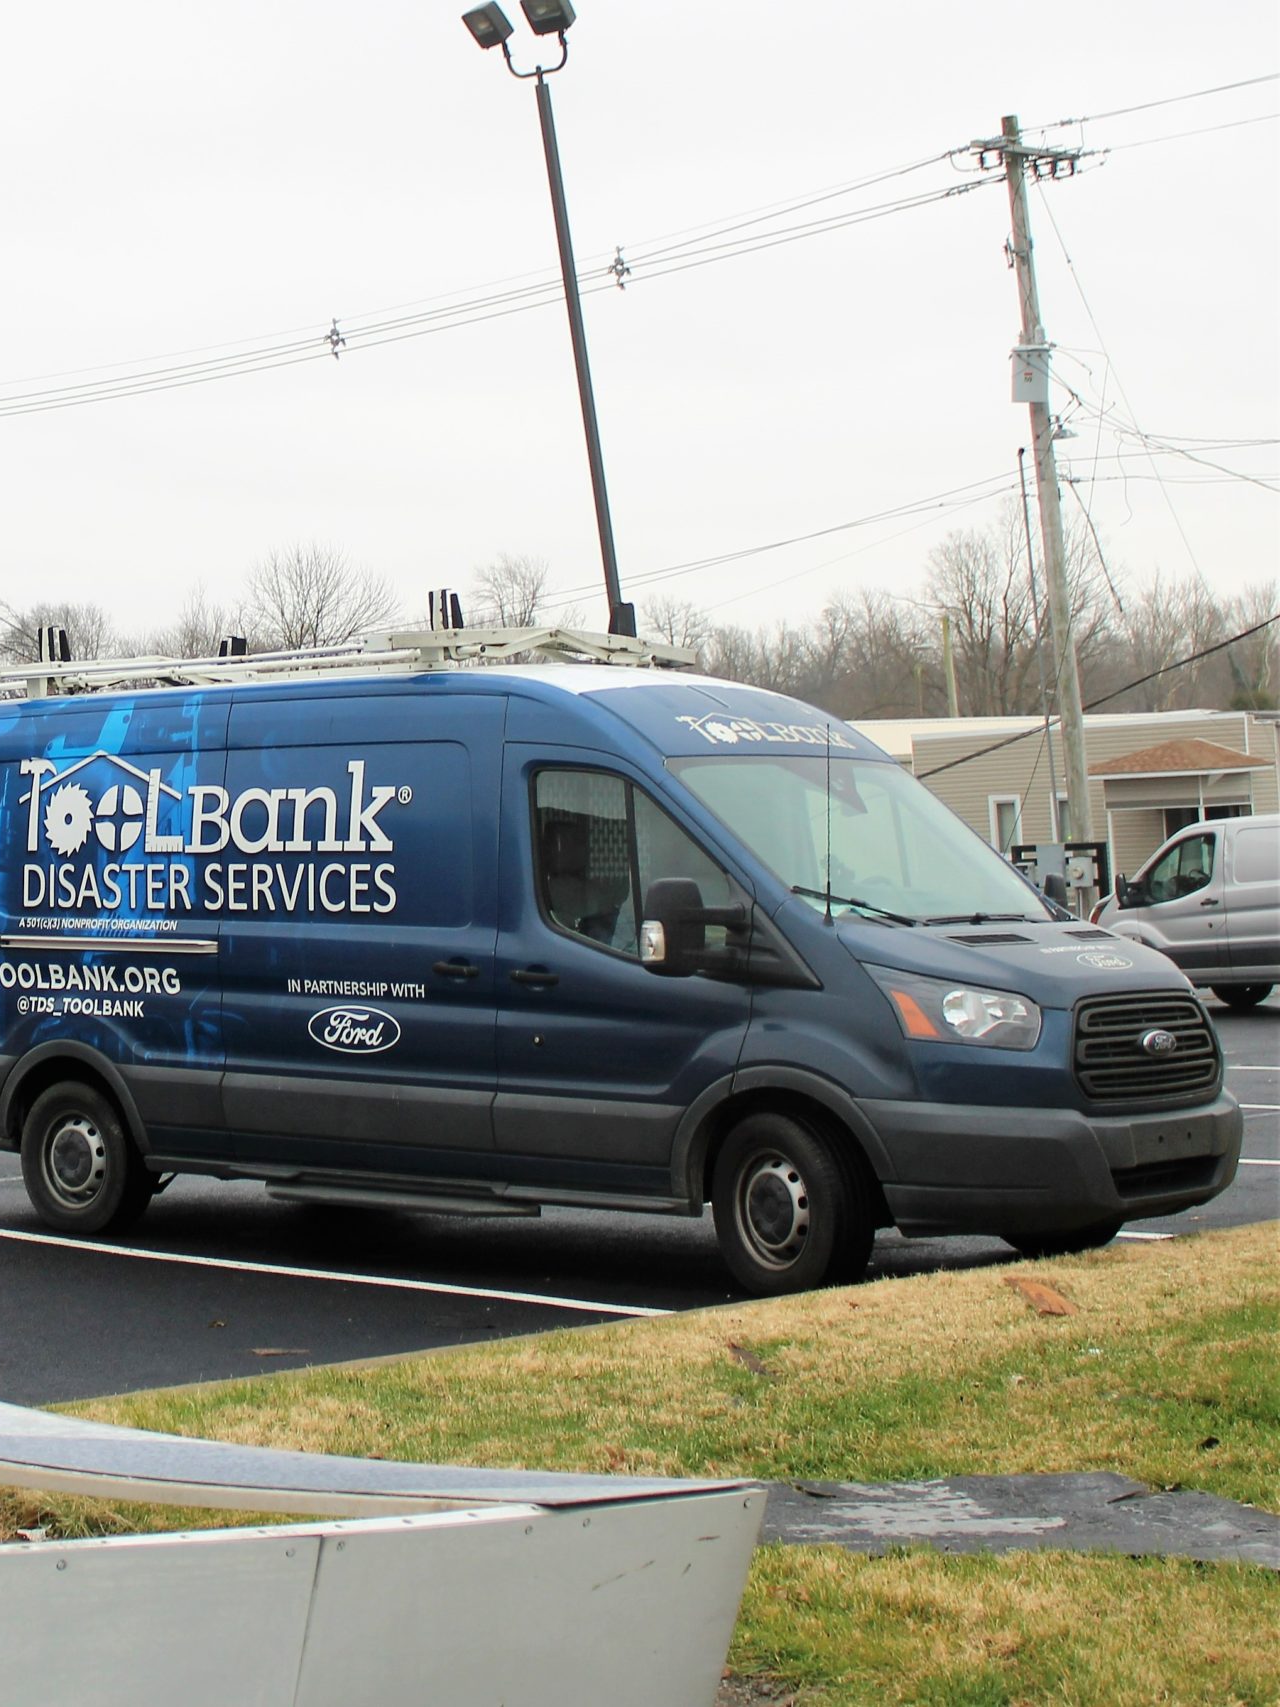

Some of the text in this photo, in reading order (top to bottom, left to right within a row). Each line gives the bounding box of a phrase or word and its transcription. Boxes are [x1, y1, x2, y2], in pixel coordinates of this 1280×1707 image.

[23, 863, 397, 913] DISASTER SERVICES
[19, 919, 25, 928] A
[61, 919, 111, 929] NONPROFIT
[111, 920, 178, 931] ORGANIZATION
[287, 979, 425, 998] IN PARTNERSHIP WITH
[17, 996, 145, 1018] @TDS_TOOLBANK
[324, 1011, 385, 1046] Ford
